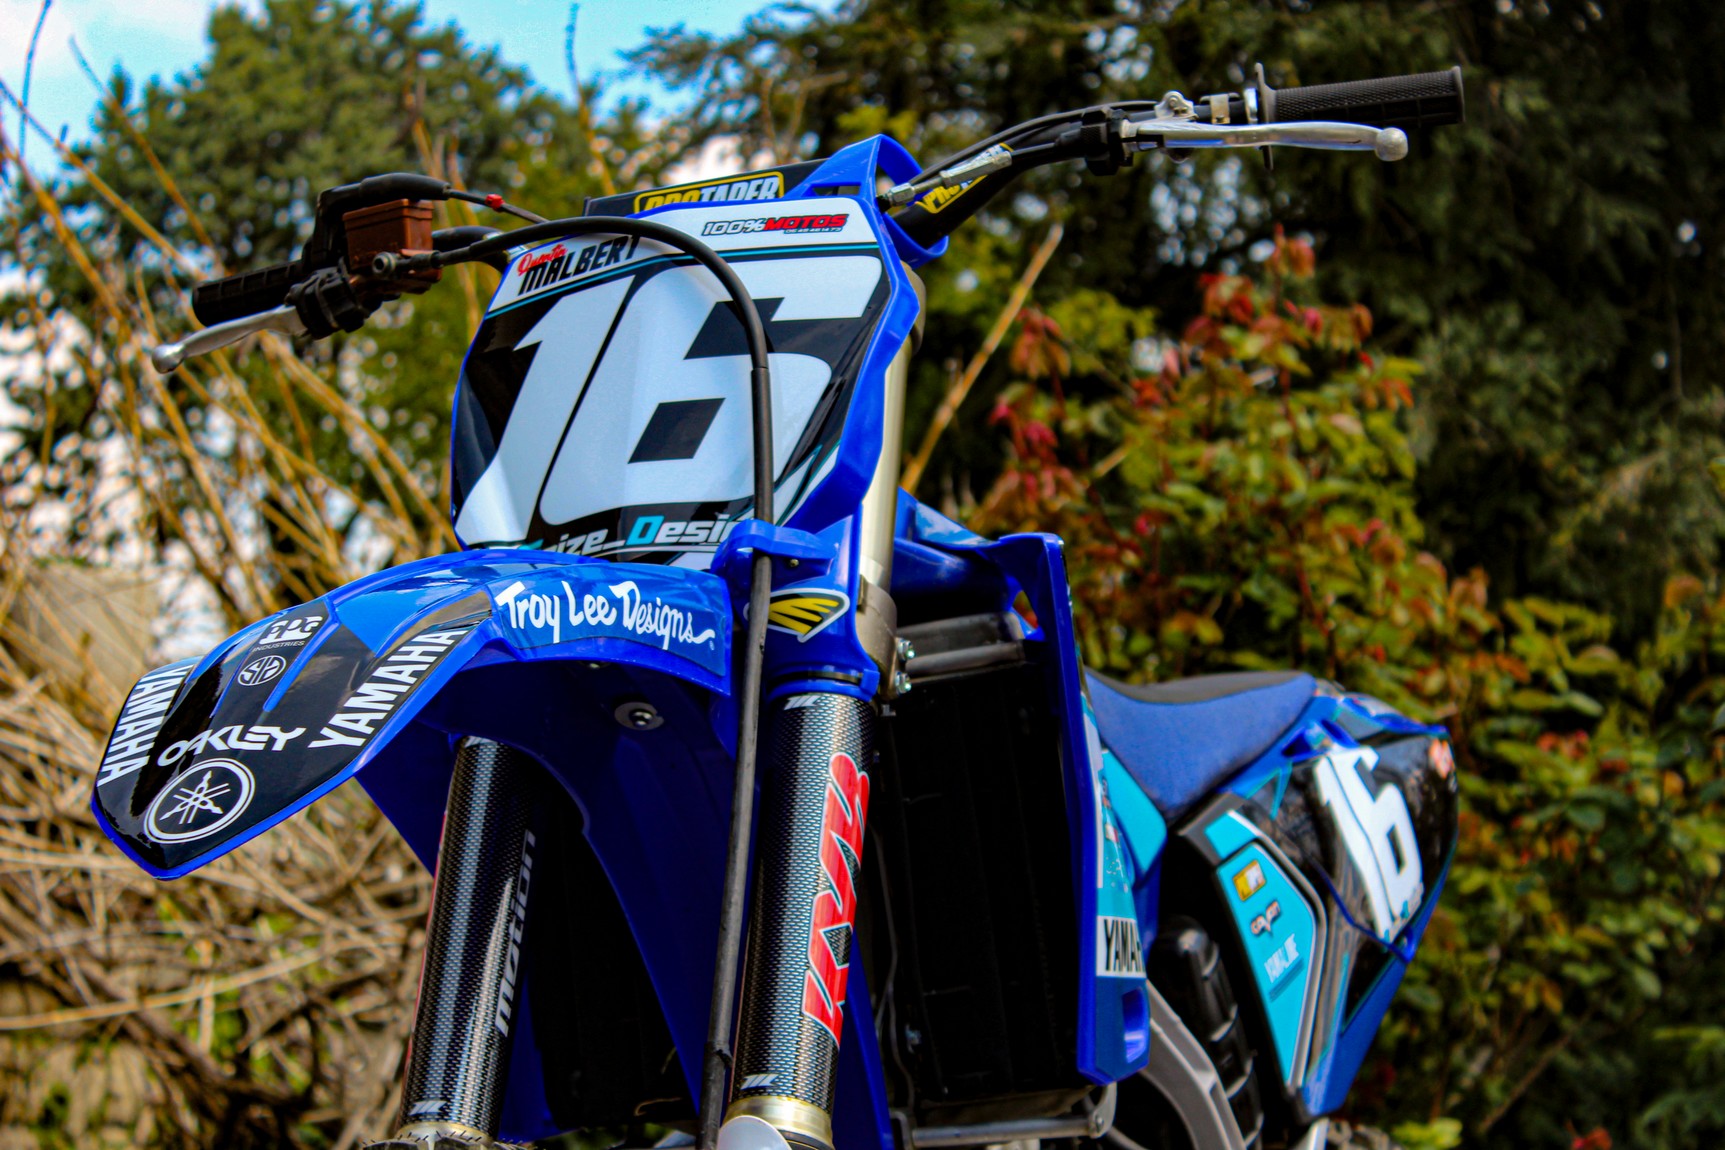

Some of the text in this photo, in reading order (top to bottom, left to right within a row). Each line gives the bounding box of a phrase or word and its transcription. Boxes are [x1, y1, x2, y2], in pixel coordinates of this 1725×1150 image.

[518, 235, 640, 296] MALBERT
[455, 255, 882, 544] 16
[251, 641, 306, 653] INDUSTRIES
[495, 581, 715, 650] Troy Lee Designs
[97, 665, 192, 787] YAMAHA
[157, 725, 306, 767] OAKLEY
[308, 630, 468, 749] YAMAHA
[1313, 746, 1424, 942] 16
[495, 829, 536, 1038] motion
